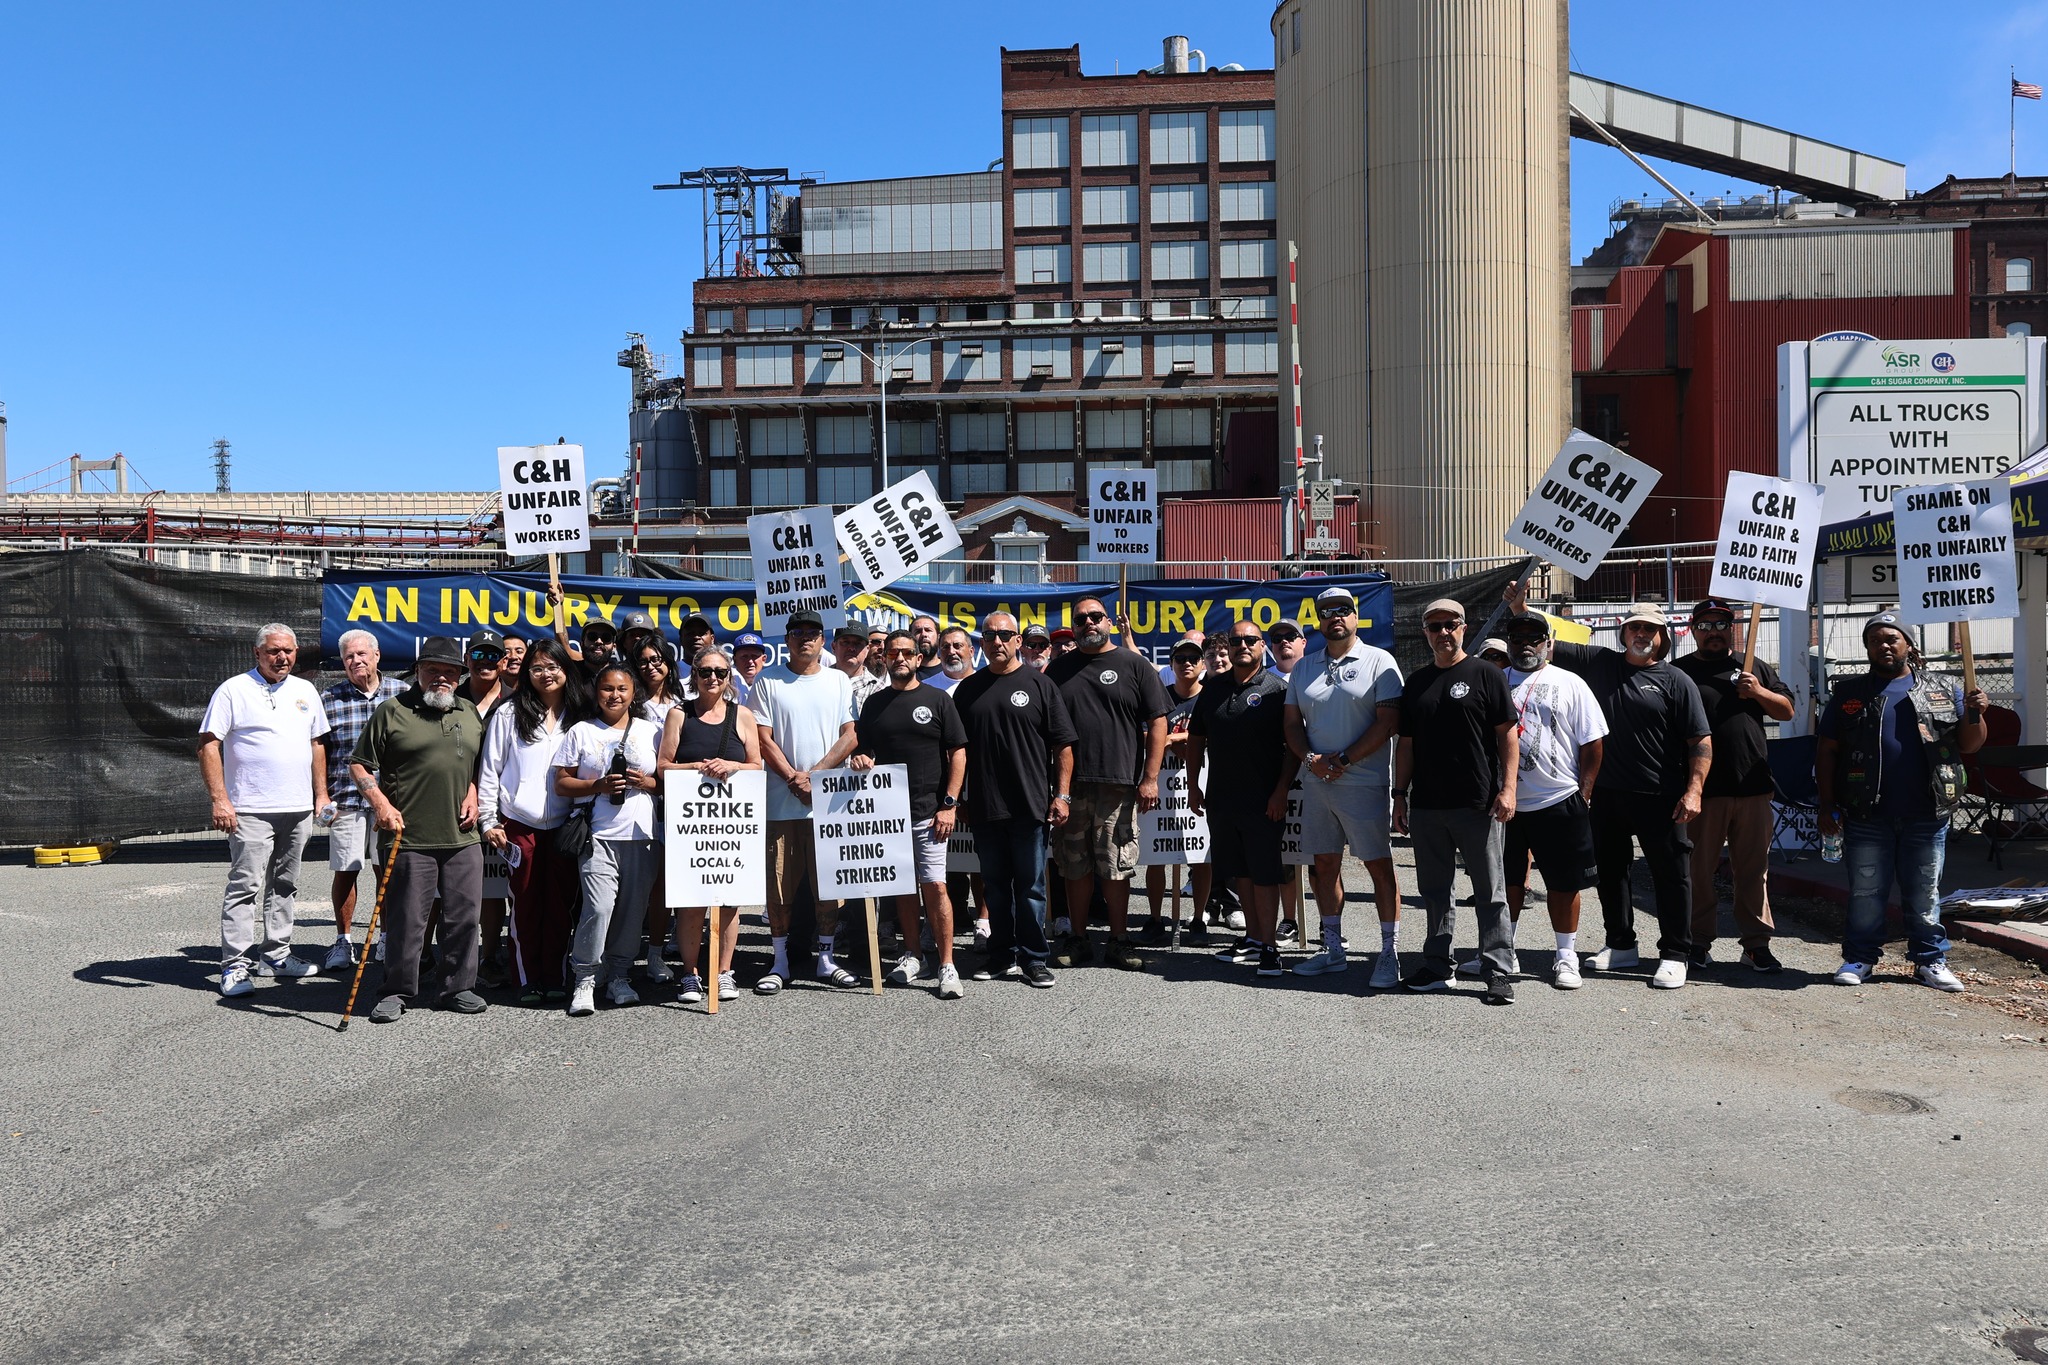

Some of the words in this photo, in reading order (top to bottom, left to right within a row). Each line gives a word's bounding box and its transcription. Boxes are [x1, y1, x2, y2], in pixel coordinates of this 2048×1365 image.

[1886, 354, 1920, 367] ASR
[1850, 404, 1892, 422] ALL
[1898, 403, 1990, 421] TRUCKS
[1889, 430, 1948, 448] WITH
[513, 459, 571, 484] C&H
[1829, 456, 2011, 476] APPOINTMENTS
[1568, 453, 1637, 504] C&H
[508, 490, 581, 510] UNFAIR
[1100, 481, 1146, 502] C&H
[1907, 490, 1962, 512] SHAME
[1968, 488, 1991, 505] ON
[1540, 479, 1621, 534] UNFAIR
[1752, 491, 1796, 520] C&H
[535, 514, 552, 525] TO
[901, 491, 943, 547] C&H
[1094, 509, 1152, 524] UNFAIR
[1555, 515, 1574, 532] TO
[1937, 514, 1970, 534] C&H
[515, 529, 580, 544] WORKERS
[773, 524, 813, 550] C&H
[871, 530, 886, 548] TO
[873, 497, 919, 567] UNFAIR
[1114, 528, 1127, 538] TO
[1739, 520, 1786, 541] UNFAIR
[1790, 529, 1799, 543] &
[844, 519, 884, 580] WORKERS
[1097, 543, 1149, 553] WORKERS
[1305, 541, 1339, 549] TRACKS
[1522, 520, 1592, 564] WORKERS
[1903, 544, 1932, 560] FOR
[1937, 536, 2007, 557] UNFAIRLY
[1730, 541, 1757, 558] BAD
[1762, 546, 1797, 565] FAITH
[768, 556, 810, 573] UNFAIR
[815, 554, 824, 567] &
[1927, 562, 1981, 583] FIRING
[767, 579, 790, 595] BAD
[794, 574, 826, 591] FAITH
[1720, 562, 1803, 588] BARGAINING
[346, 586, 418, 623] AN
[440, 588, 623, 627] INJURY
[639, 596, 700, 629] TO
[765, 595, 837, 617] BARGAINING
[1922, 587, 1995, 609] STRIKERS
[939, 602, 977, 634] IS
[1226, 598, 1281, 632] TO
[1297, 597, 1372, 630] AL
[698, 782, 733, 798] ON
[822, 775, 868, 793] SHAME
[872, 773, 892, 789] ON
[682, 802, 754, 818] STRIKE
[847, 798, 875, 815] C&H
[677, 824, 759, 835] WAREHOUSE
[819, 823, 843, 839] FOR
[847, 818, 905, 837] UNFAIRLY
[1157, 816, 1196, 831] FIRING
[695, 840, 741, 851] UNION
[839, 842, 885, 861] FIRING
[1153, 836, 1205, 852] STRIKERS
[690, 857, 731, 868] LOCAL
[733, 857, 745, 869] 6,
[702, 874, 734, 884] ILWU
[836, 865, 897, 885] STRIKERS
